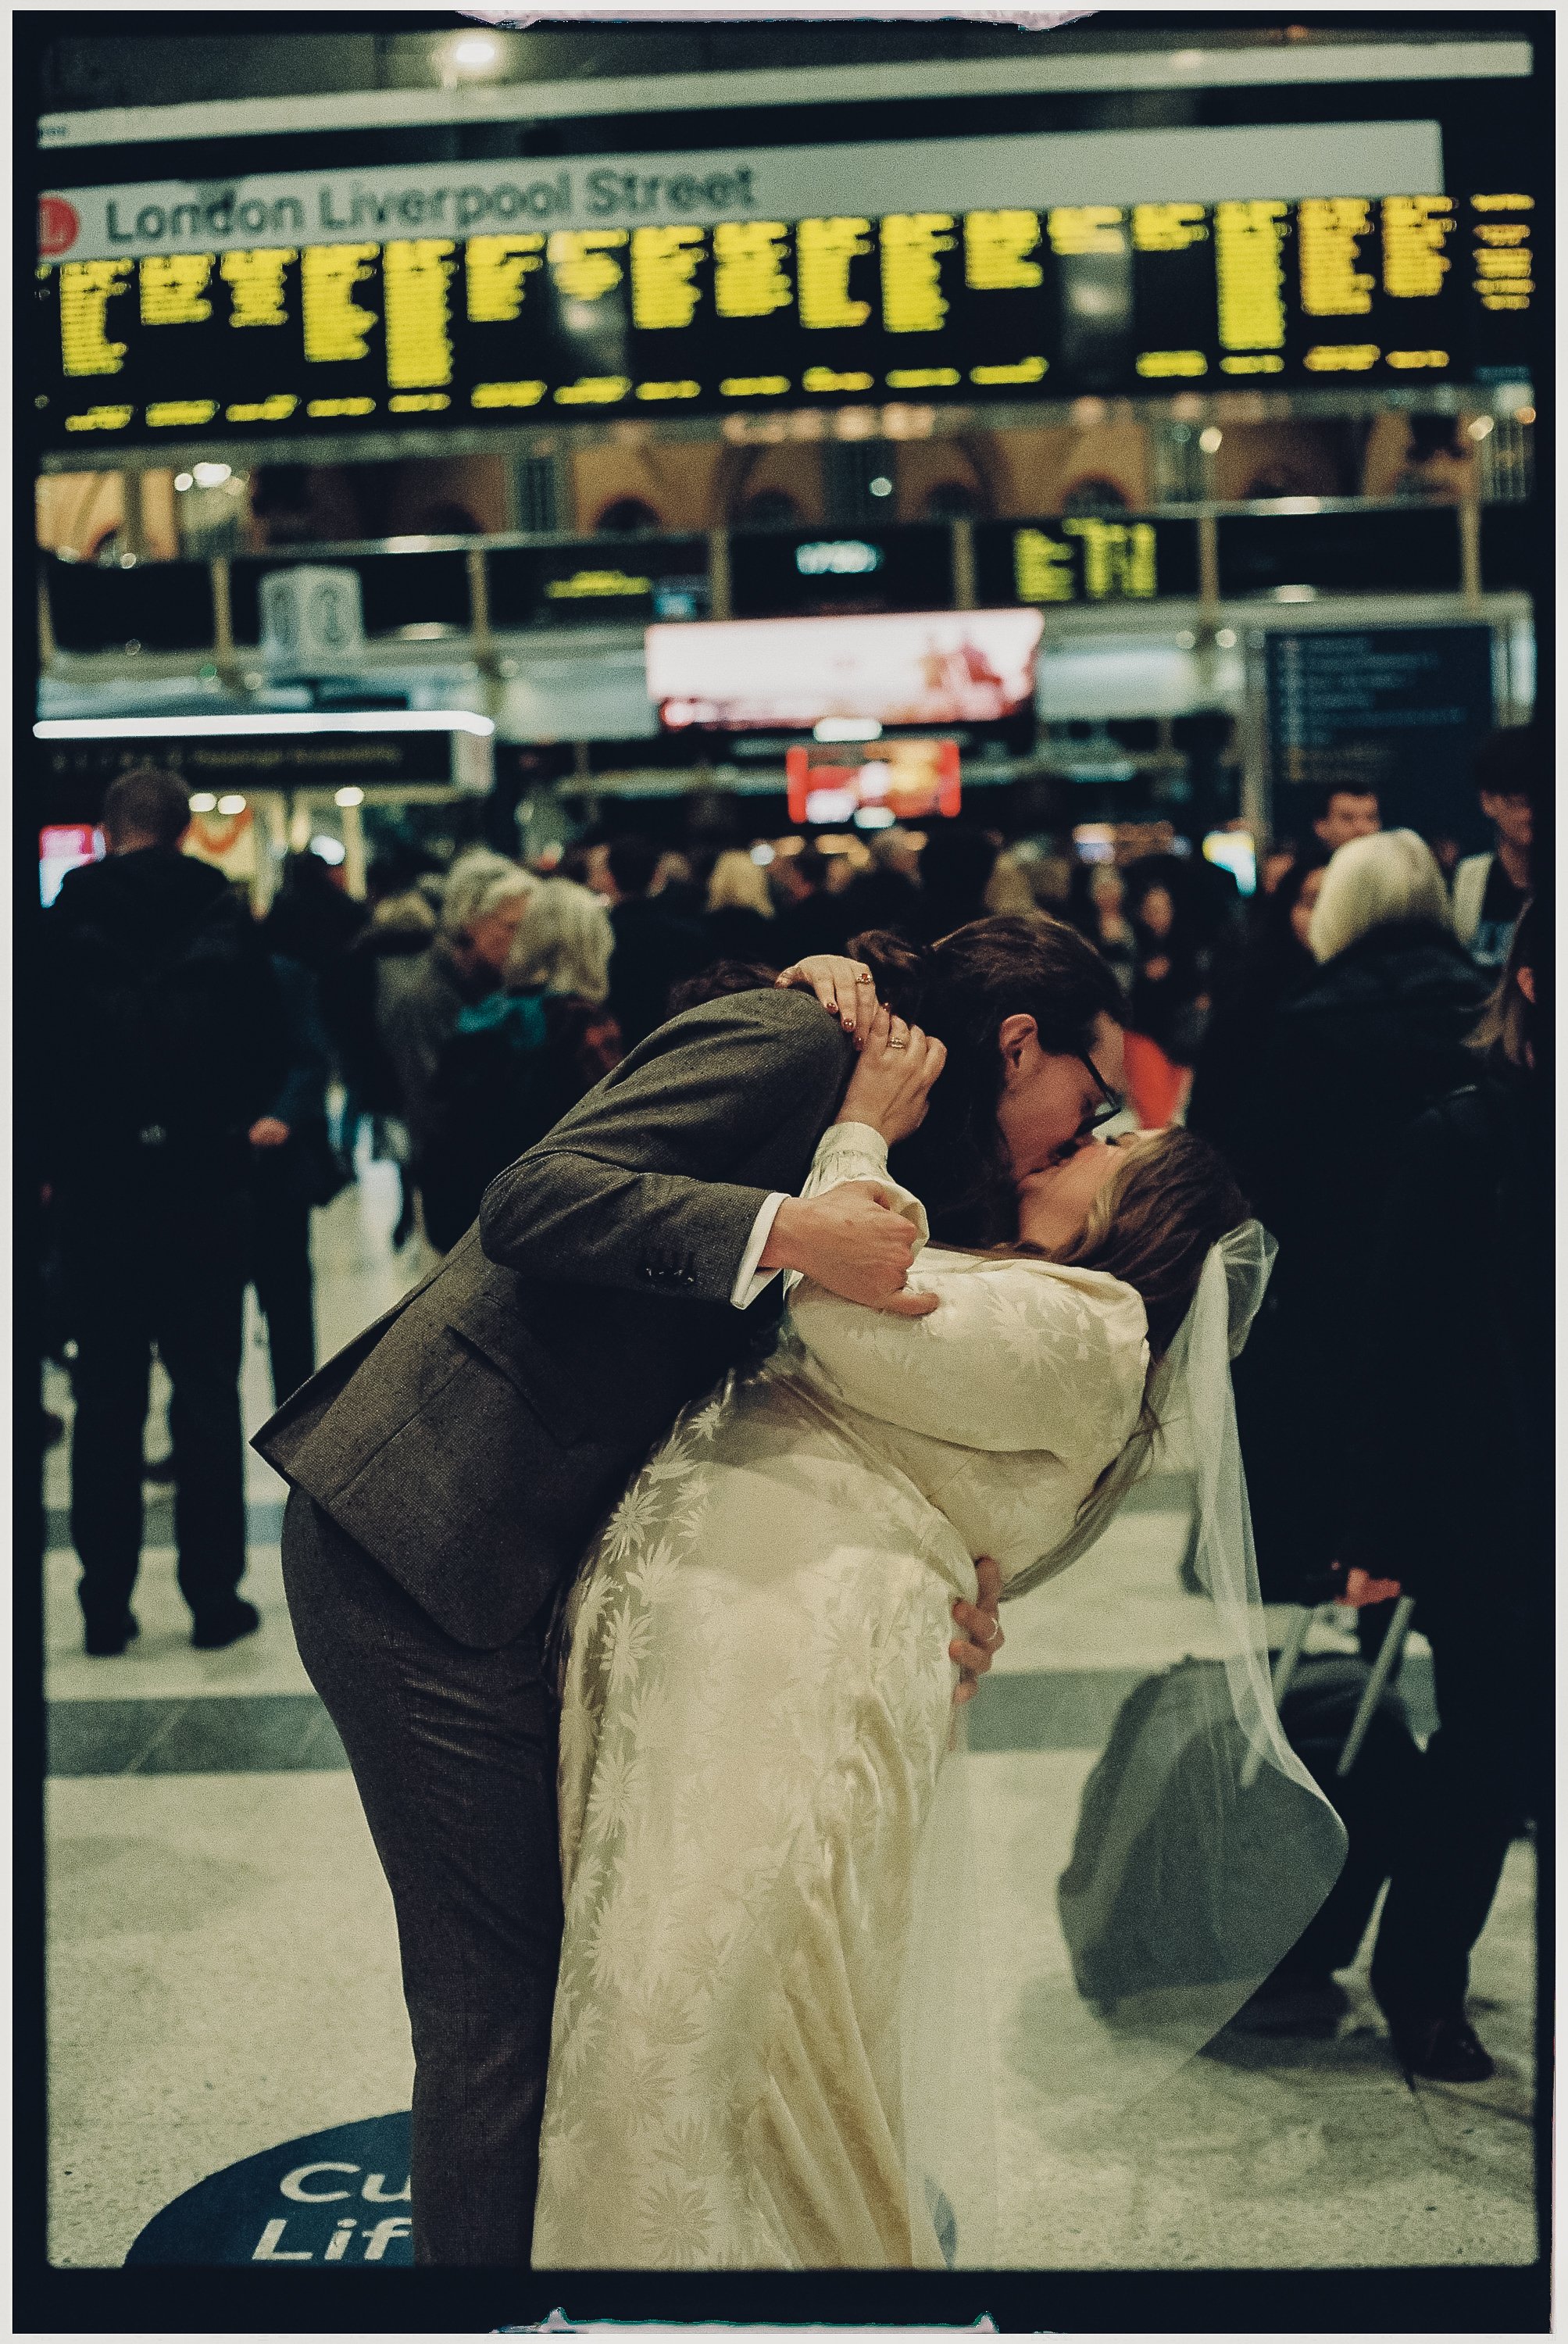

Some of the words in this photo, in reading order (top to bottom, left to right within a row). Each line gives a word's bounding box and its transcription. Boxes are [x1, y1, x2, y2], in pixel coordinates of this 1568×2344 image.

[105, 191, 306, 244] London
[318, 168, 572, 231] Liverpool
[585, 164, 753, 216] Street
